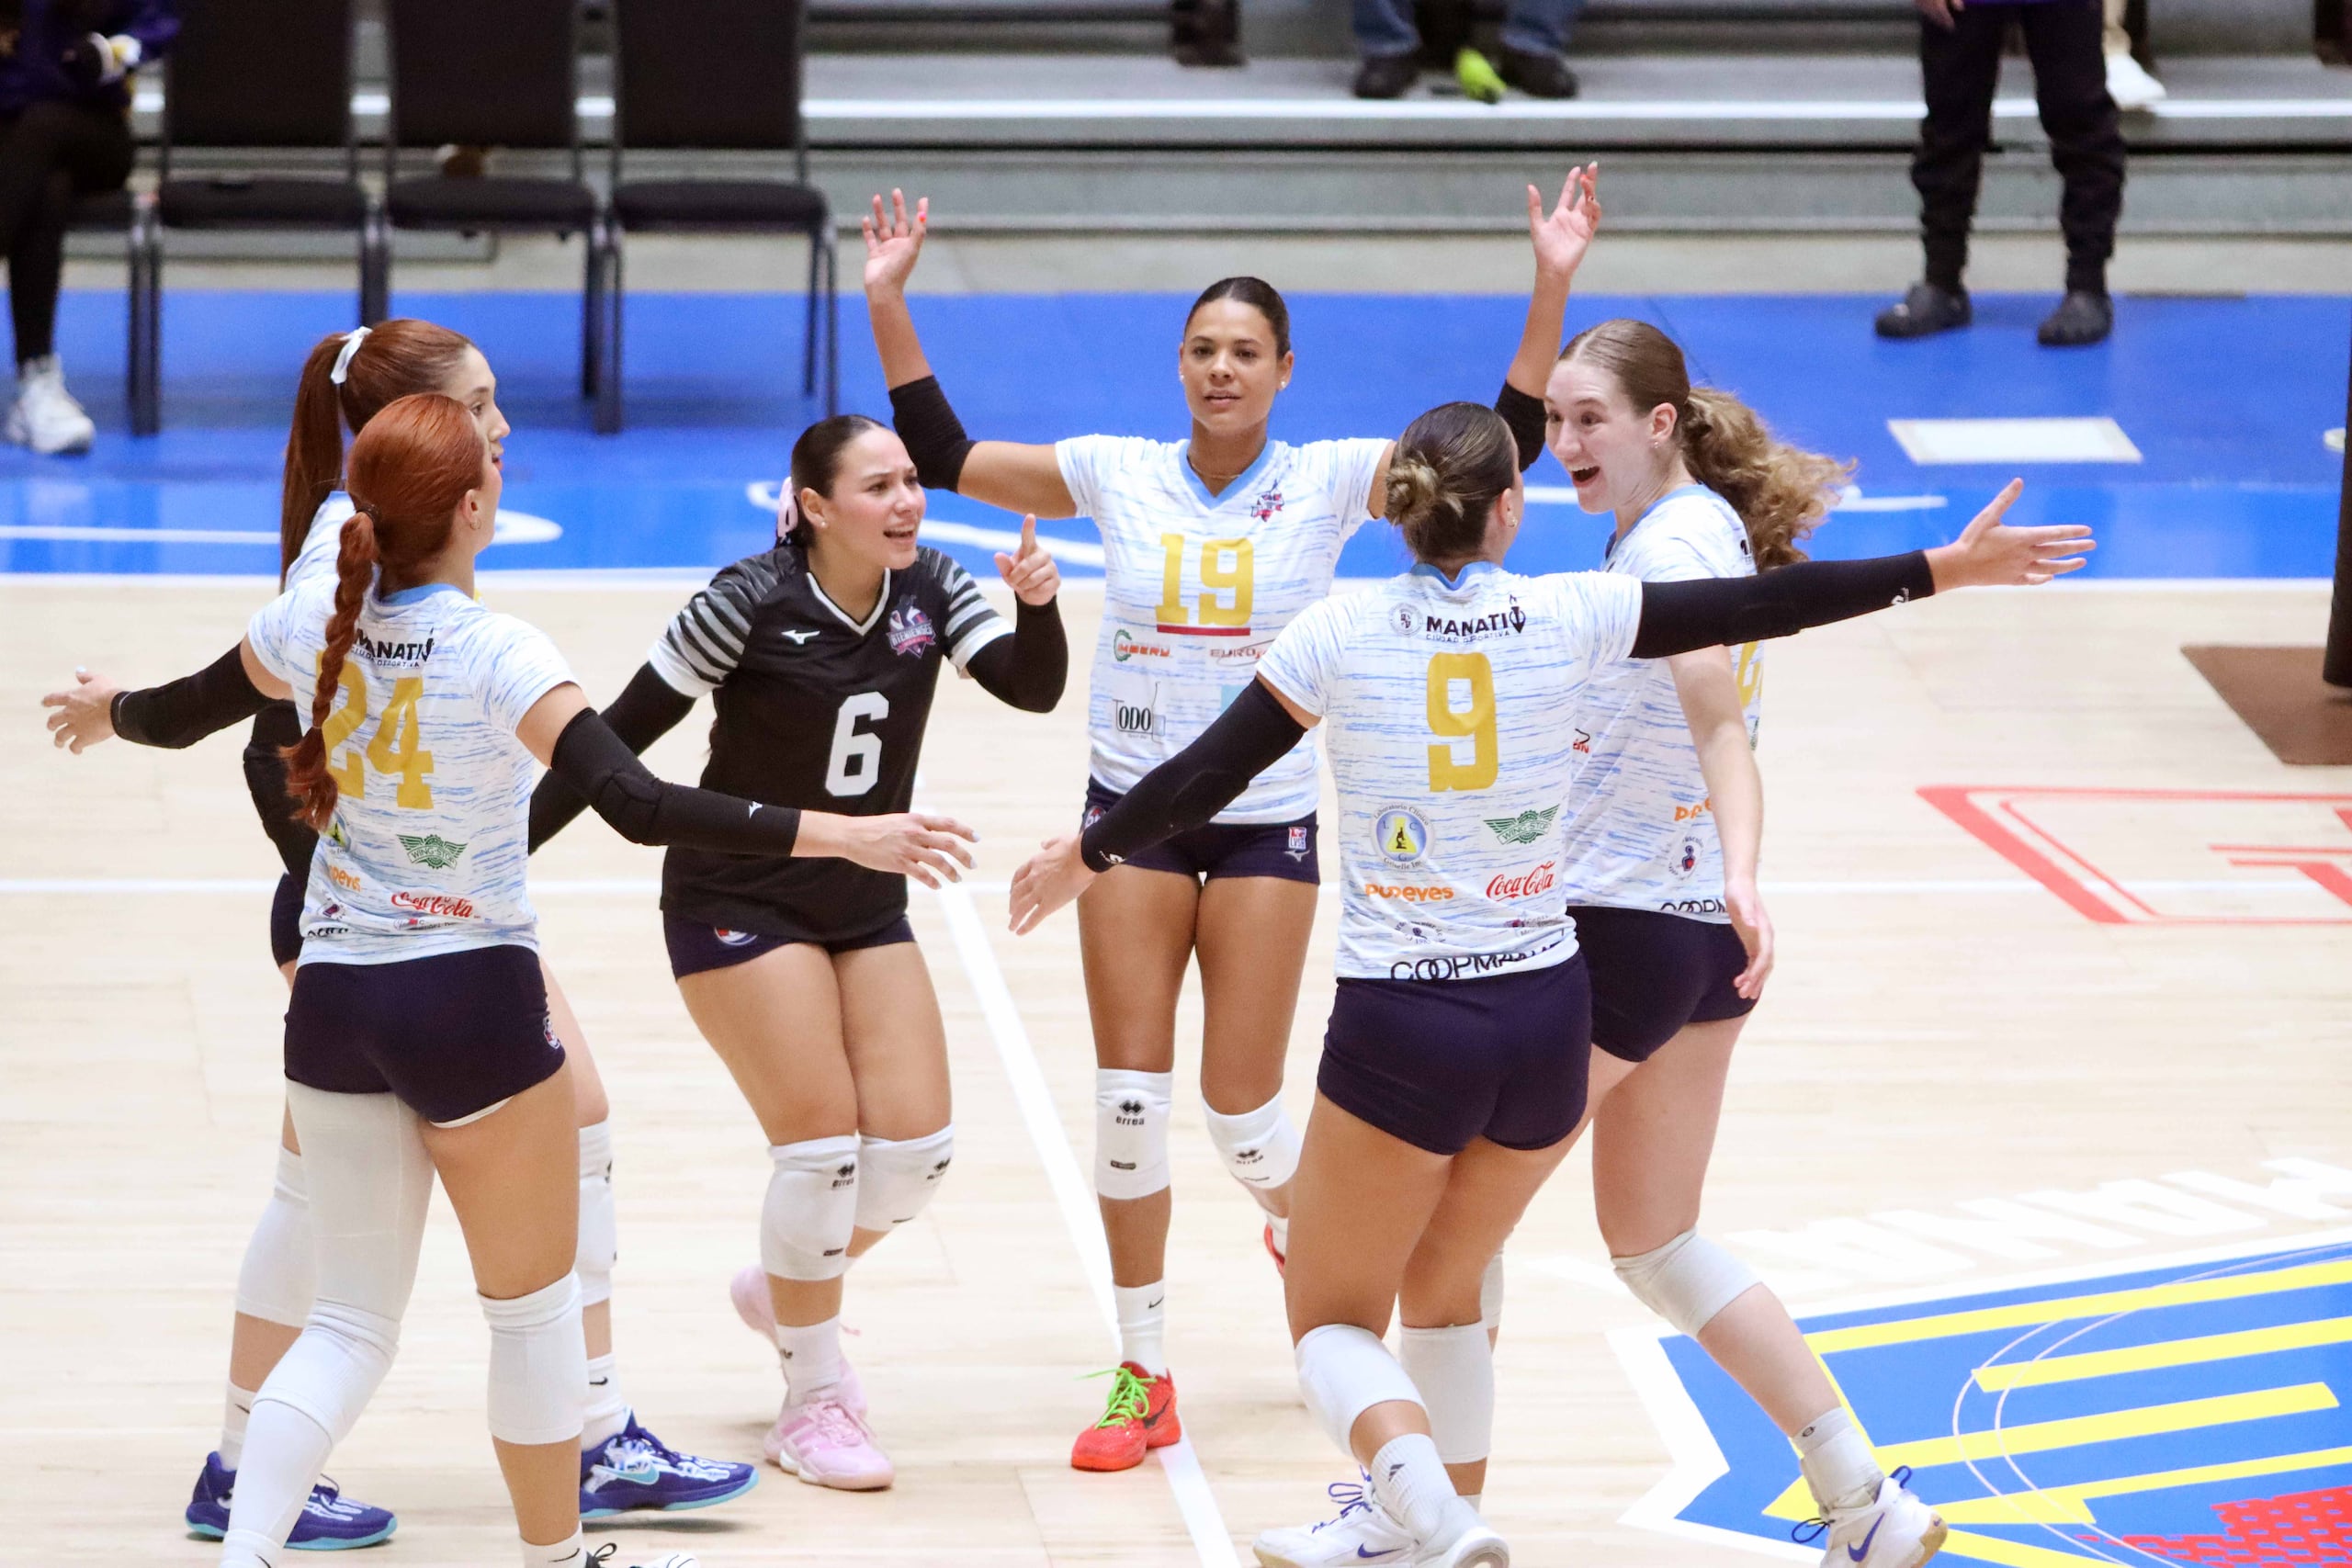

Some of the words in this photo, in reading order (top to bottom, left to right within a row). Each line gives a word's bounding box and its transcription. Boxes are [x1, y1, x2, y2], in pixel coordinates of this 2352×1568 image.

[1155, 533, 1254, 626] 19
[316, 650, 434, 809] 24
[826, 691, 890, 797] 6
[1427, 651, 1499, 792] 9
[390, 891, 473, 919] Coca-Cola
[1486, 860, 1556, 902] Coca-Cola
